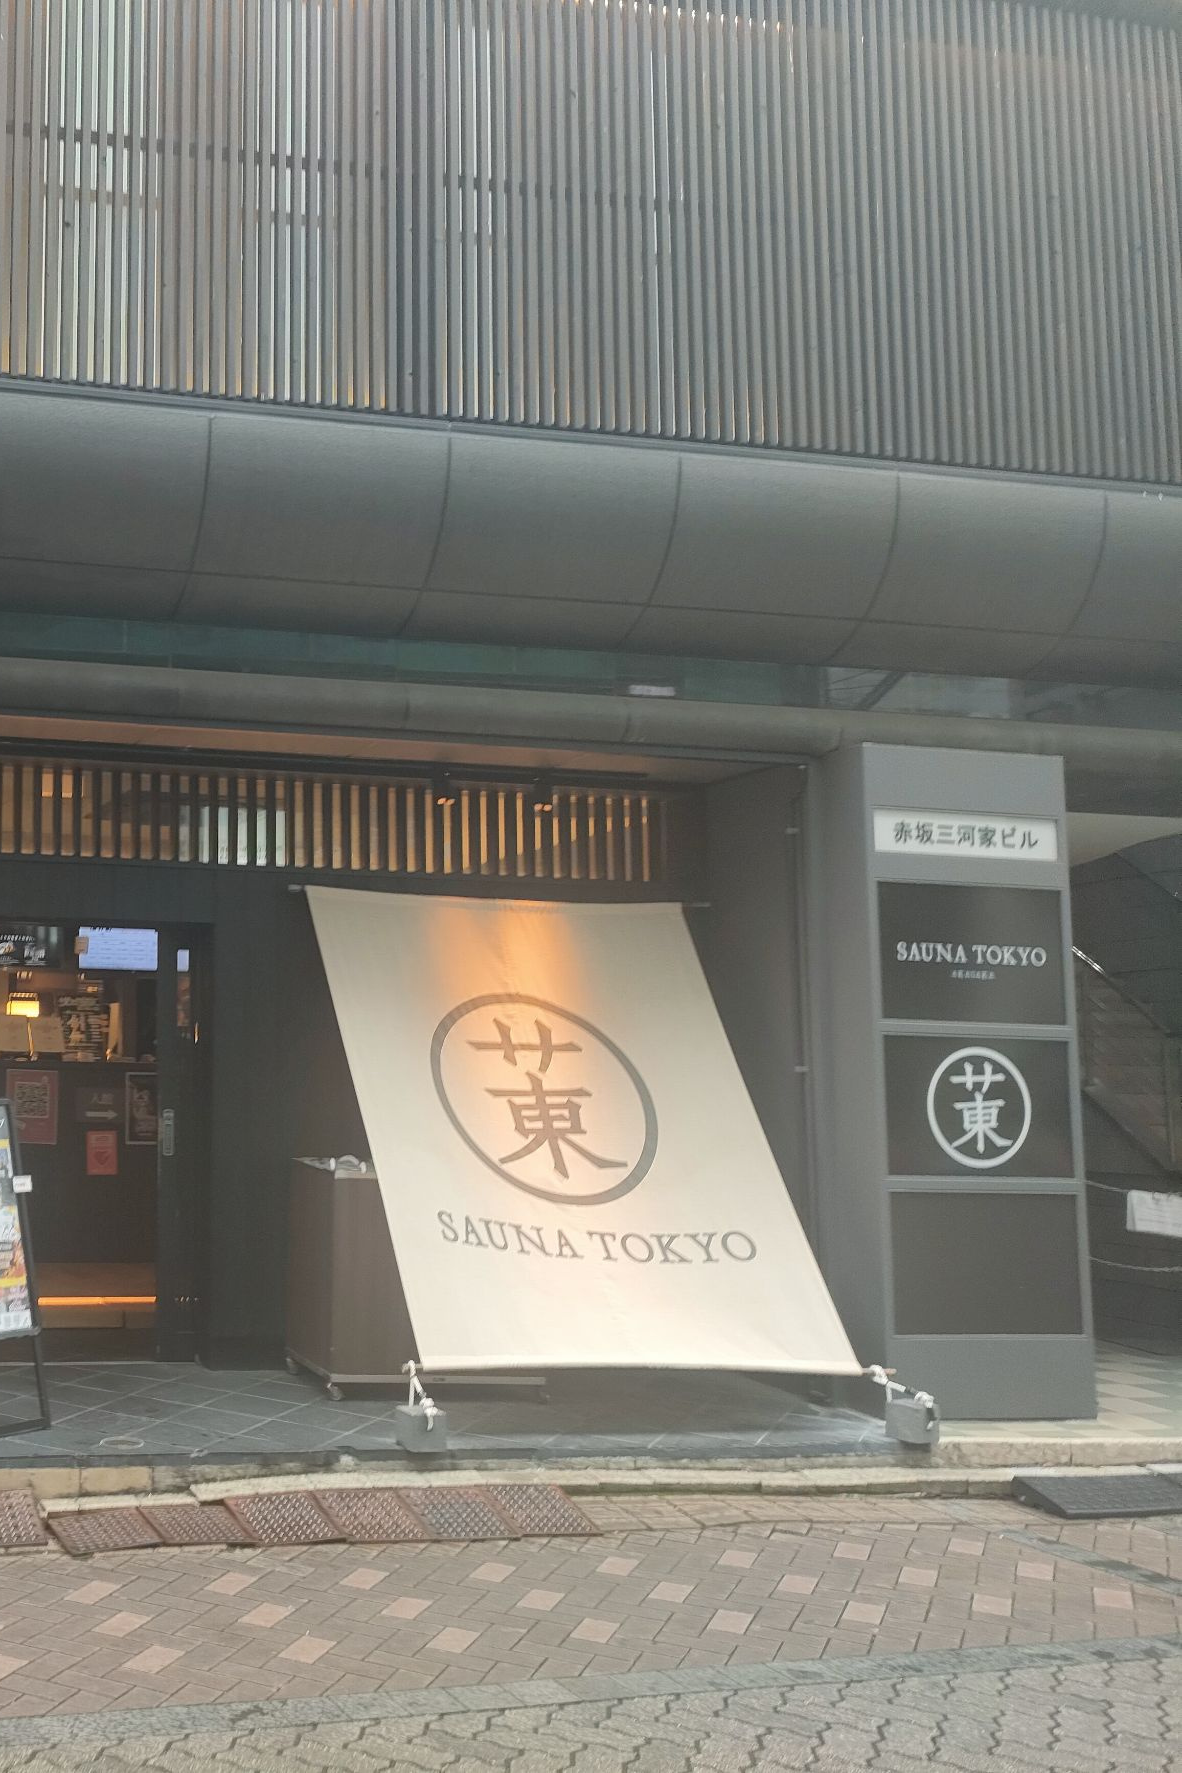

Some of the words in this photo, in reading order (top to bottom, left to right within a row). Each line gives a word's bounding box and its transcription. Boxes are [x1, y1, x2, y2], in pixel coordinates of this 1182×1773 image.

[893, 820, 1039, 848] 赤坂三河家ビル
[896, 941, 968, 964] SAUNA
[971, 944, 1047, 967] TOKYO
[436, 1209, 585, 1260] SAUNA
[587, 1230, 757, 1264] TOKYO
